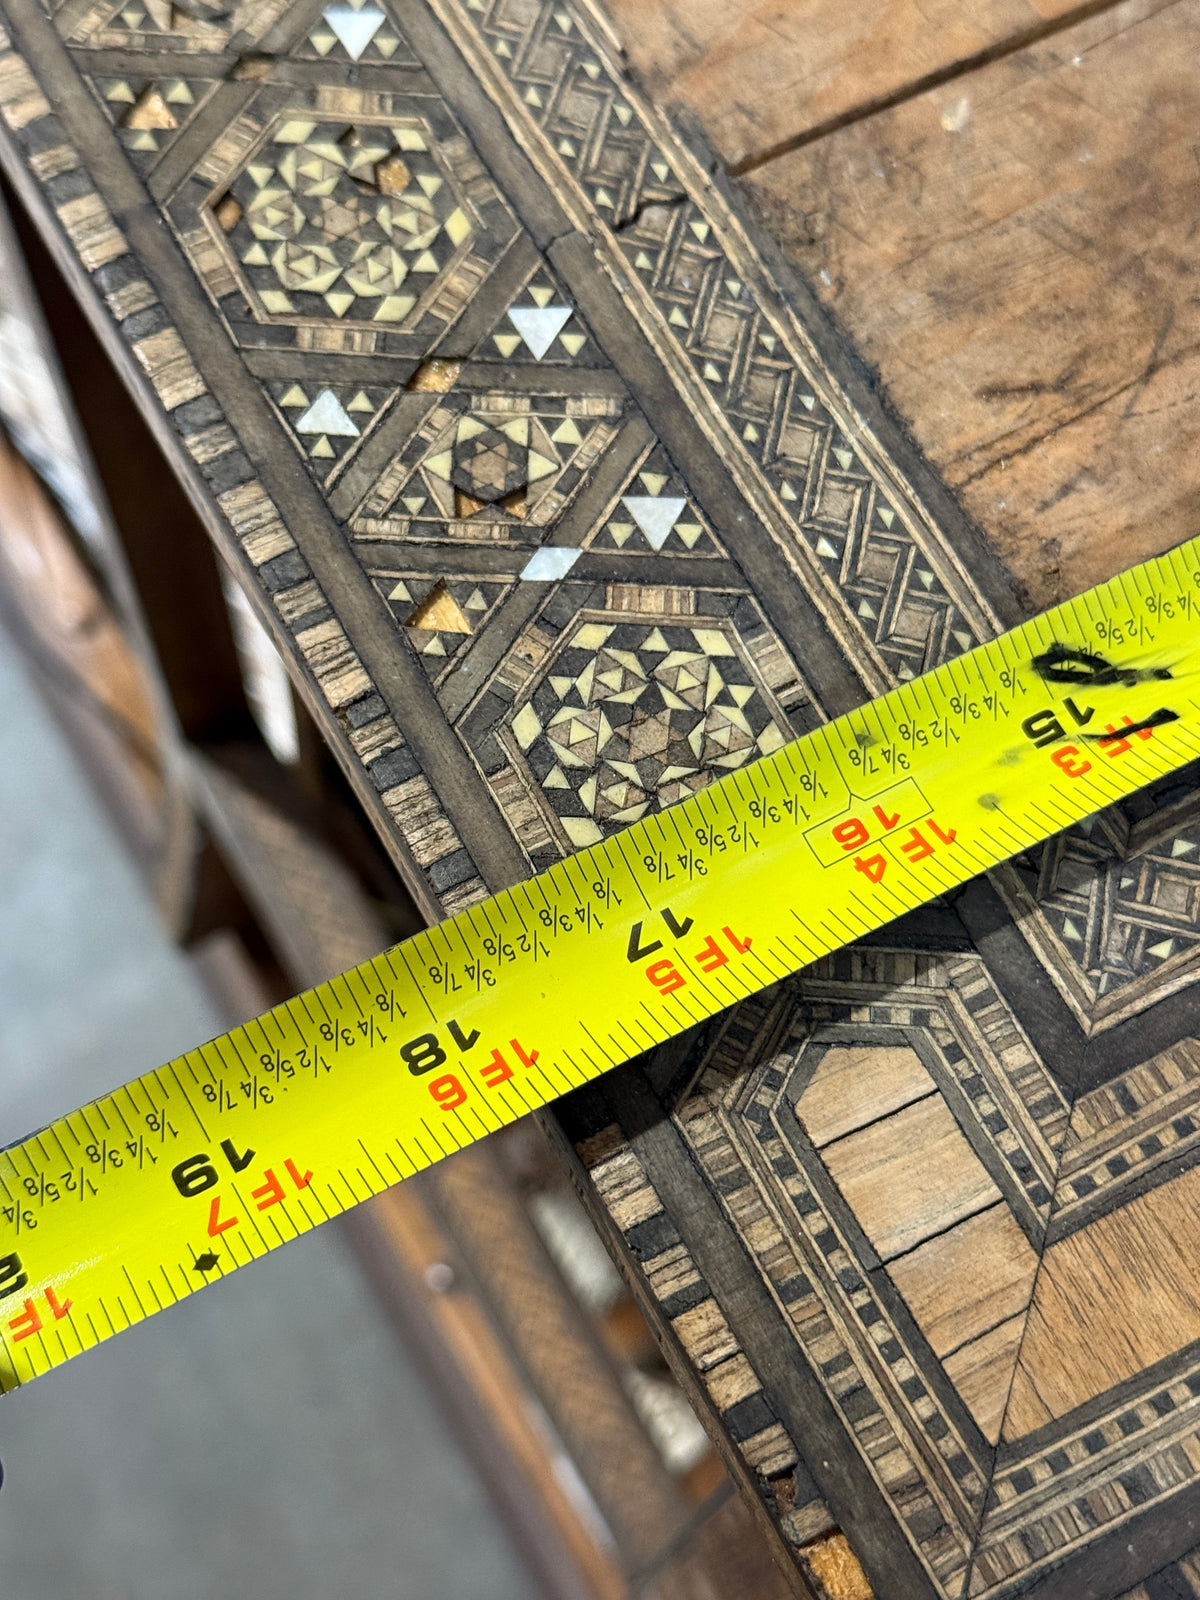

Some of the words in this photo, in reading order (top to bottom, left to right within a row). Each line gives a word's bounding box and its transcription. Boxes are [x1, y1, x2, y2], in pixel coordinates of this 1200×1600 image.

[1145, 593, 1174, 623] 3/8
[1095, 618, 1124, 648] 5/8
[1125, 615, 1155, 646] 1/2
[1000, 667, 1027, 698] 1/8
[950, 693, 981, 724] 3/8
[983, 691, 1010, 721] 1/4
[898, 720, 928, 750] 5/8
[928, 717, 960, 748] 1/2
[1021, 697, 1095, 749] 15
[849, 745, 879, 776] 7/8
[881, 743, 911, 774] 3/4
[800, 770, 828, 801] 1/8
[749, 797, 781, 828] 3/8
[783, 794, 811, 825] 1/4
[695, 824, 727, 856] 5/8
[727, 821, 760, 852] 1/2
[832, 804, 901, 851] 16
[643, 851, 675, 883] 7/8
[677, 848, 708, 880] 3/4
[592, 877, 623, 910] 1/8
[538, 904, 573, 937] 3/8
[574, 901, 604, 934] 1/4
[483, 933, 516, 966] 5/8
[516, 930, 551, 962] 1/2
[626, 907, 694, 964] 17
[428, 962, 463, 995] 7/8
[464, 959, 497, 992] 3/4
[375, 989, 407, 1022] 1/8
[319, 1018, 355, 1052] 3/8
[357, 1014, 388, 1048] 1/4
[295, 1044, 332, 1078] 1/2
[399, 1019, 481, 1077] 18
[260, 1049, 296, 1083] 5/8
[202, 1079, 238, 1113] 7/8
[240, 1075, 274, 1110] 3/4
[145, 1108, 179, 1143] 1/8
[85, 1139, 124, 1174] 3/8
[126, 1134, 158, 1169] 1/4
[171, 1138, 257, 1198] 19
[23, 1171, 61, 1207] 5/8
[60, 1166, 99, 1201] 1/2
[2, 1200, 38, 1235] 3/4
